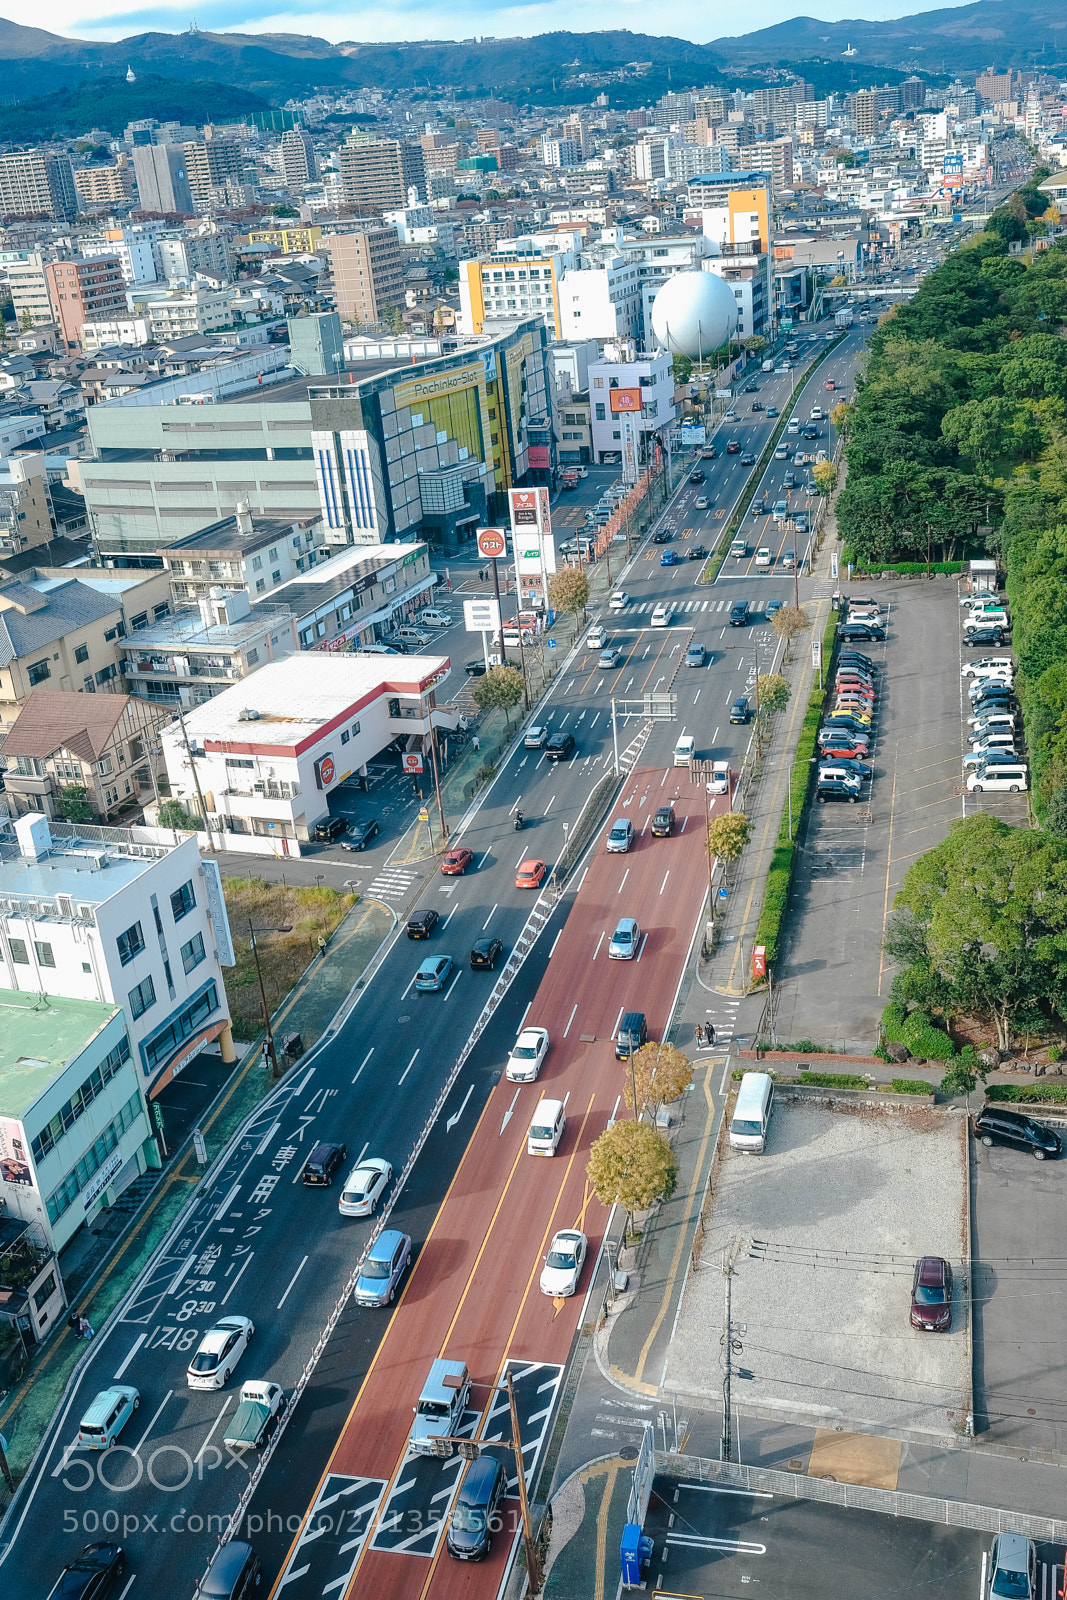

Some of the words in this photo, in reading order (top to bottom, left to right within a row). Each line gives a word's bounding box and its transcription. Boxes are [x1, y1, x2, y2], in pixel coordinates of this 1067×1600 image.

[414, 370, 478, 396] Pachinko-Slot
[712, 509, 726, 520] 50
[679, 528, 694, 540] 50
[482, 541, 502, 549] ガスト
[643, 549, 658, 561] 50
[247, 1089, 339, 1203] バス専用
[174, 1154, 247, 1254] リフトバス停
[224, 1208, 273, 1277] タクシー
